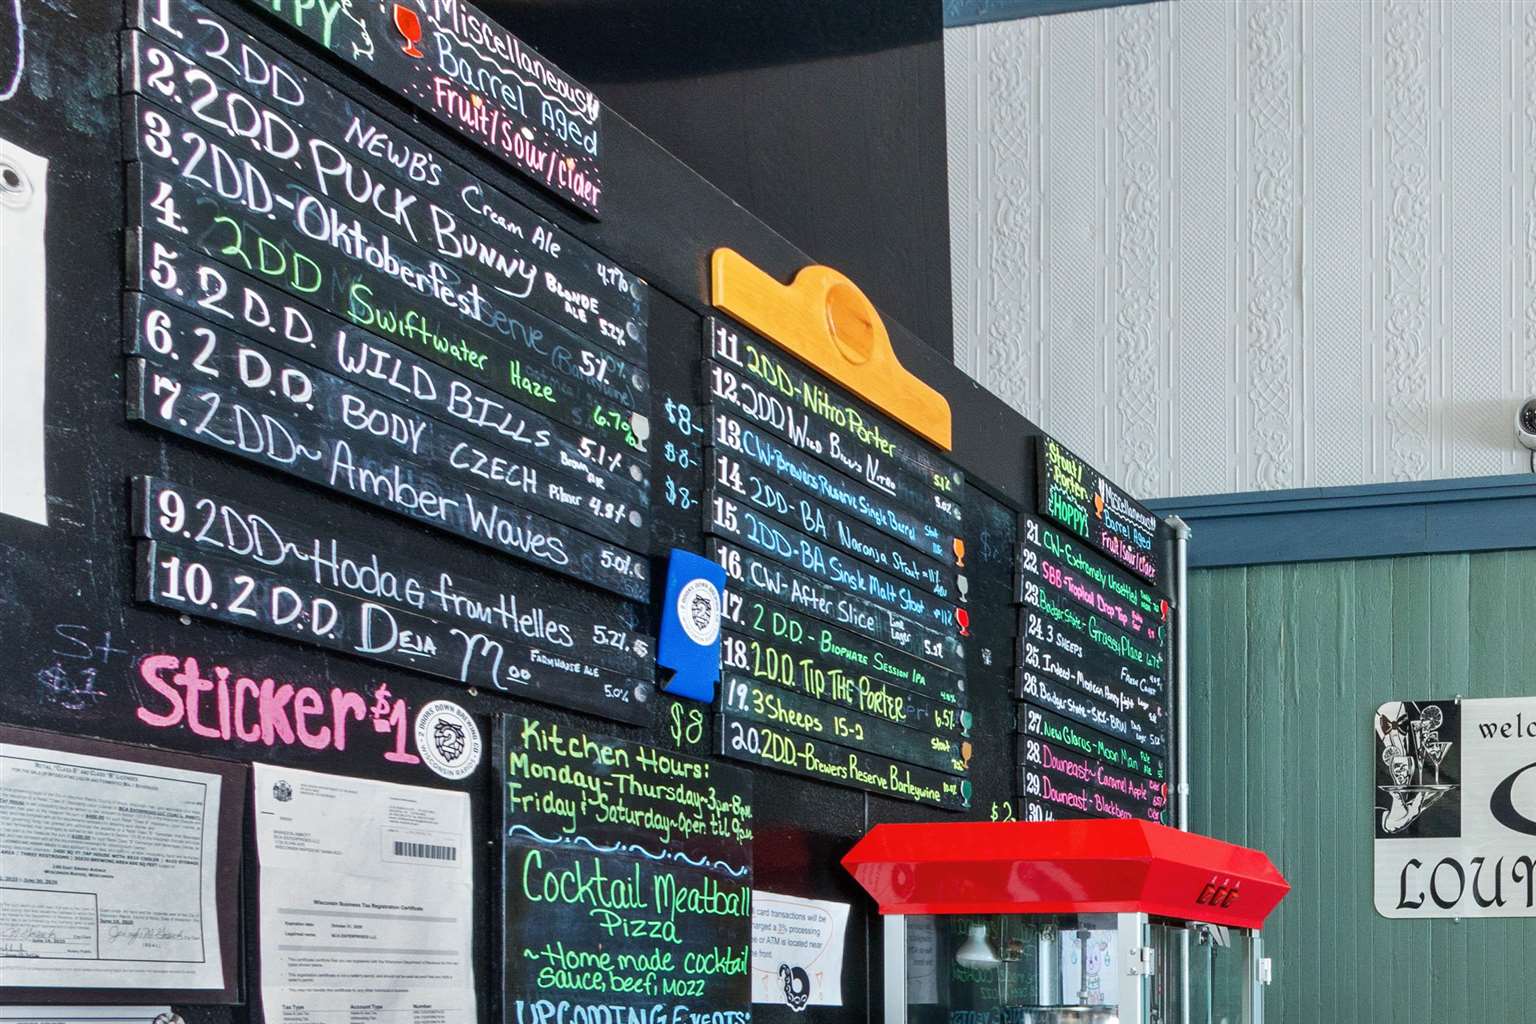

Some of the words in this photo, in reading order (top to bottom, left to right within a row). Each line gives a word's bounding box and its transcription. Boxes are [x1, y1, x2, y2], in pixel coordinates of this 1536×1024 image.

[434, 31, 527, 118] Barrel
[541, 100, 598, 156] Aged
[309, 138, 417, 242] PUCK
[430, 204, 537, 299] BUNNY
[461, 185, 524, 240] Cream
[531, 226, 561, 259] Ale
[215, 216, 322, 292] 2DD
[347, 283, 489, 370] Swiftwater
[510, 360, 556, 403] Haze
[337, 330, 437, 401] WILD
[447, 381, 550, 448] BILLS
[341, 394, 426, 454] BODY
[450, 442, 537, 494] CZECH
[466, 494, 569, 565] Waves
[800, 502, 828, 539] BA
[892, 552, 922, 581] Stout
[157, 490, 191, 539] 9.
[431, 573, 492, 625] from
[492, 594, 574, 648] Helles
[161, 557, 217, 612] 10.
[869, 571, 897, 602] Malt
[837, 600, 875, 632] Slice
[1097, 593, 1115, 619] Drop
[137, 653, 368, 752] Sticker
[828, 670, 853, 704] THE
[859, 675, 906, 721] PORTER
[522, 717, 629, 768] Kitchen
[636, 745, 709, 780] Hours:
[510, 782, 577, 833] Friday
[711, 817, 730, 837] til
[523, 850, 647, 909] Cocktail
[654, 874, 750, 922] Meatball
[590, 908, 682, 944] Pizza
[618, 941, 675, 974] made
[684, 946, 749, 976] cocktail
[610, 971, 657, 995] beef,
